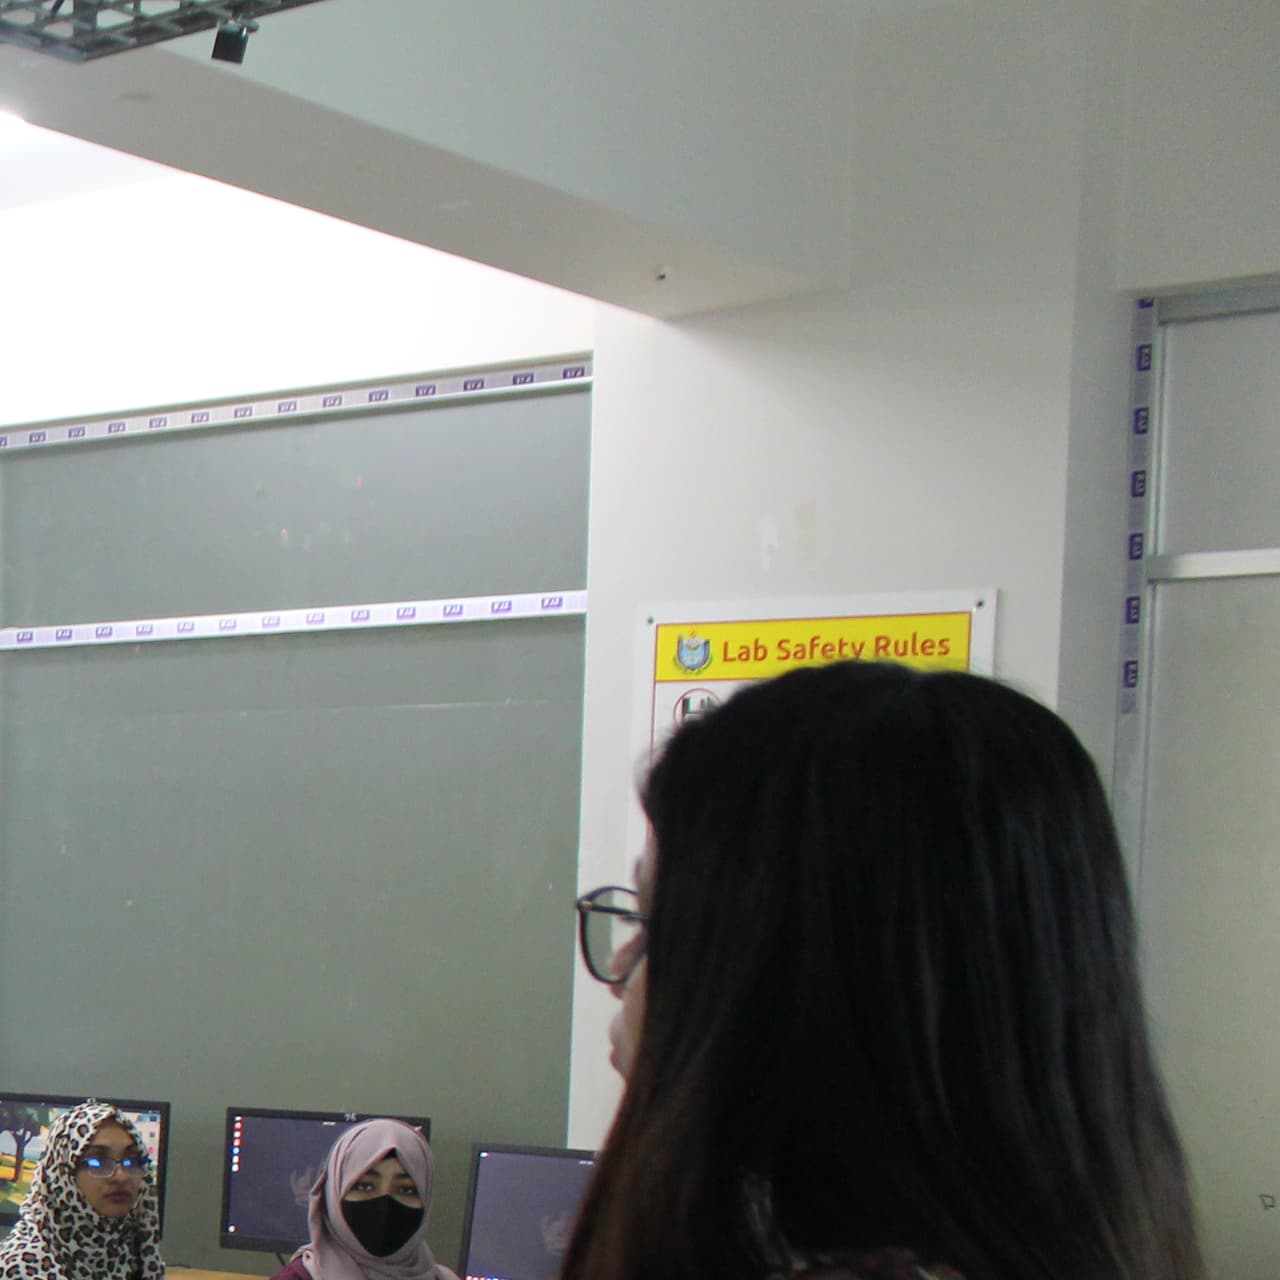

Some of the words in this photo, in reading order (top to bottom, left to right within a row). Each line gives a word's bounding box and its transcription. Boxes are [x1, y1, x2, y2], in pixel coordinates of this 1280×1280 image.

[723, 640, 767, 662] Lab
[777, 635, 865, 661] Safety
[875, 632, 950, 658] Rules
